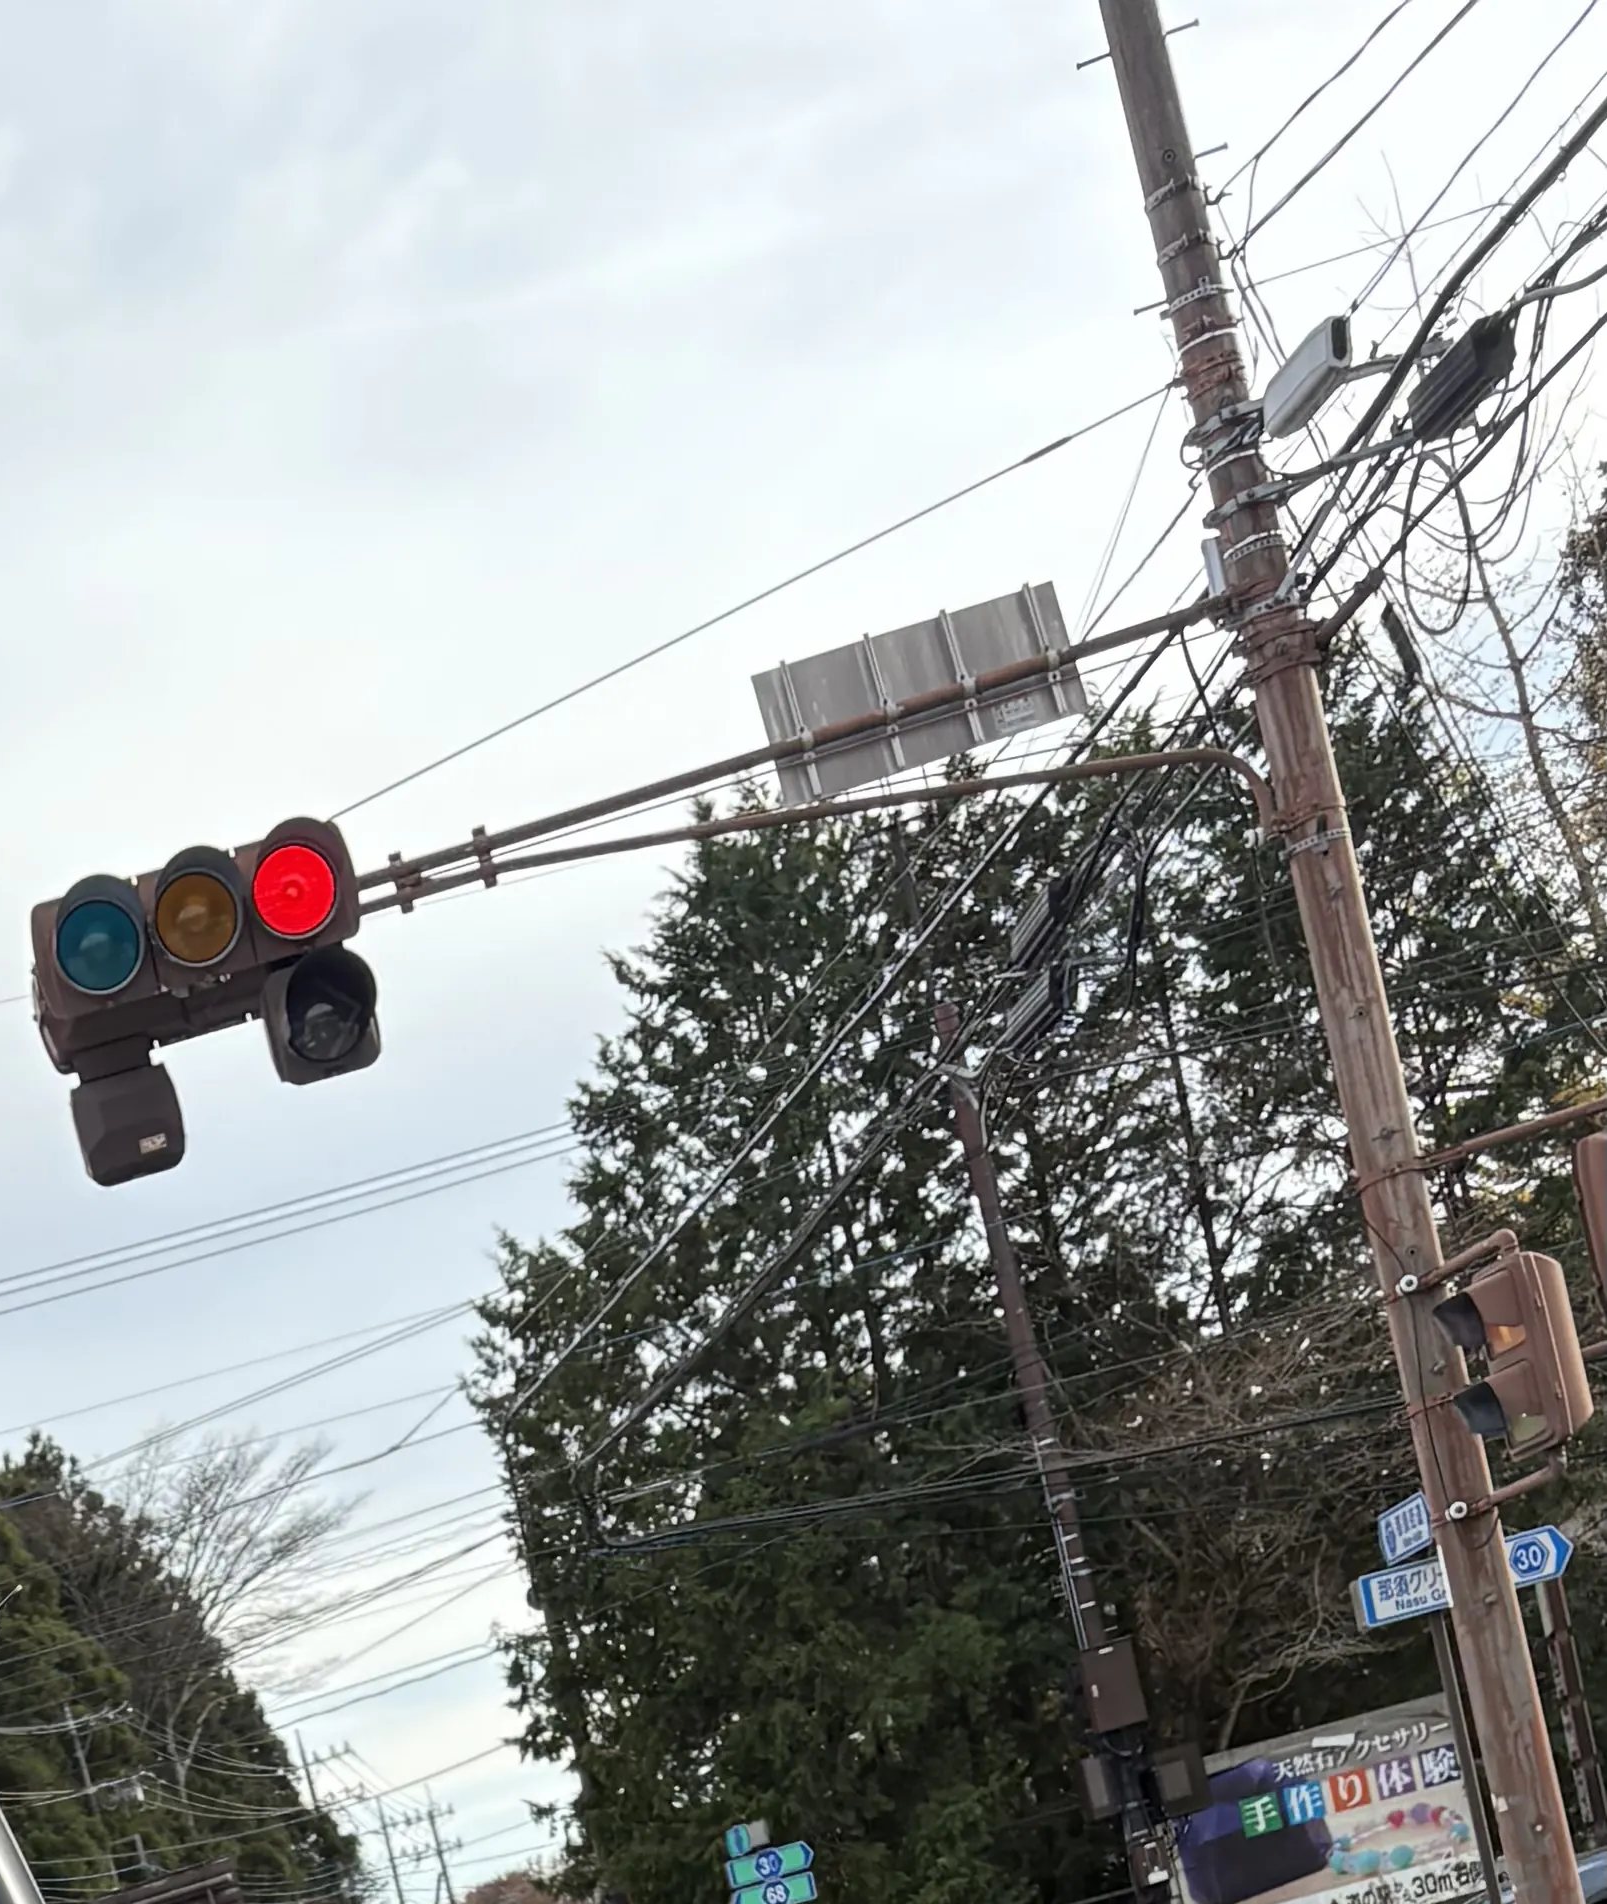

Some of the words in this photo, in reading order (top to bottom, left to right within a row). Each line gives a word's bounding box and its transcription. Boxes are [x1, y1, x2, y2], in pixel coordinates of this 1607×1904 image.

[1515, 1546, 1543, 1571] 30
[1395, 1594, 1428, 1611] Nasu
[1242, 1746, 1461, 1834] 手作り体験
[758, 1854, 780, 1876] 30
[765, 1883, 788, 1904] 68
